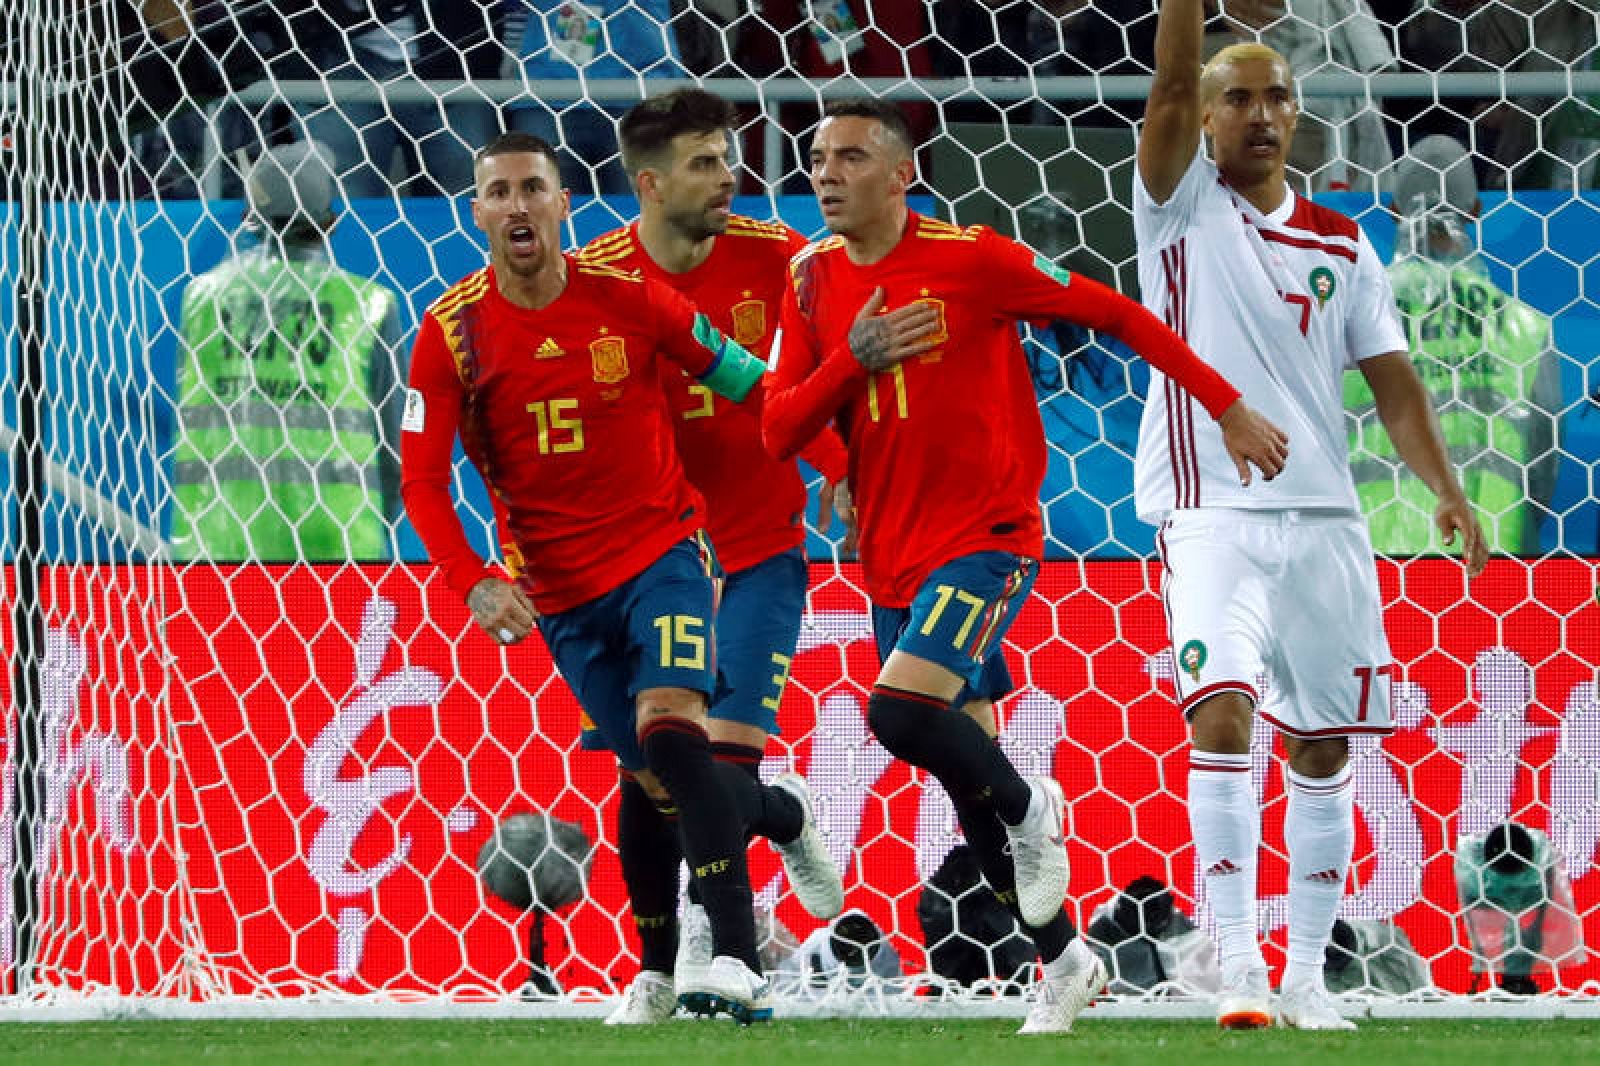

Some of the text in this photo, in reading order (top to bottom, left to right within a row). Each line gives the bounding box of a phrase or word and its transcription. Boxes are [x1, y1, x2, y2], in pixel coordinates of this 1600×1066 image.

[1277, 289, 1312, 338] 7
[526, 398, 585, 455] 15
[654, 615, 705, 671] 15
[920, 584, 985, 651] 17
[762, 652, 791, 711] 3
